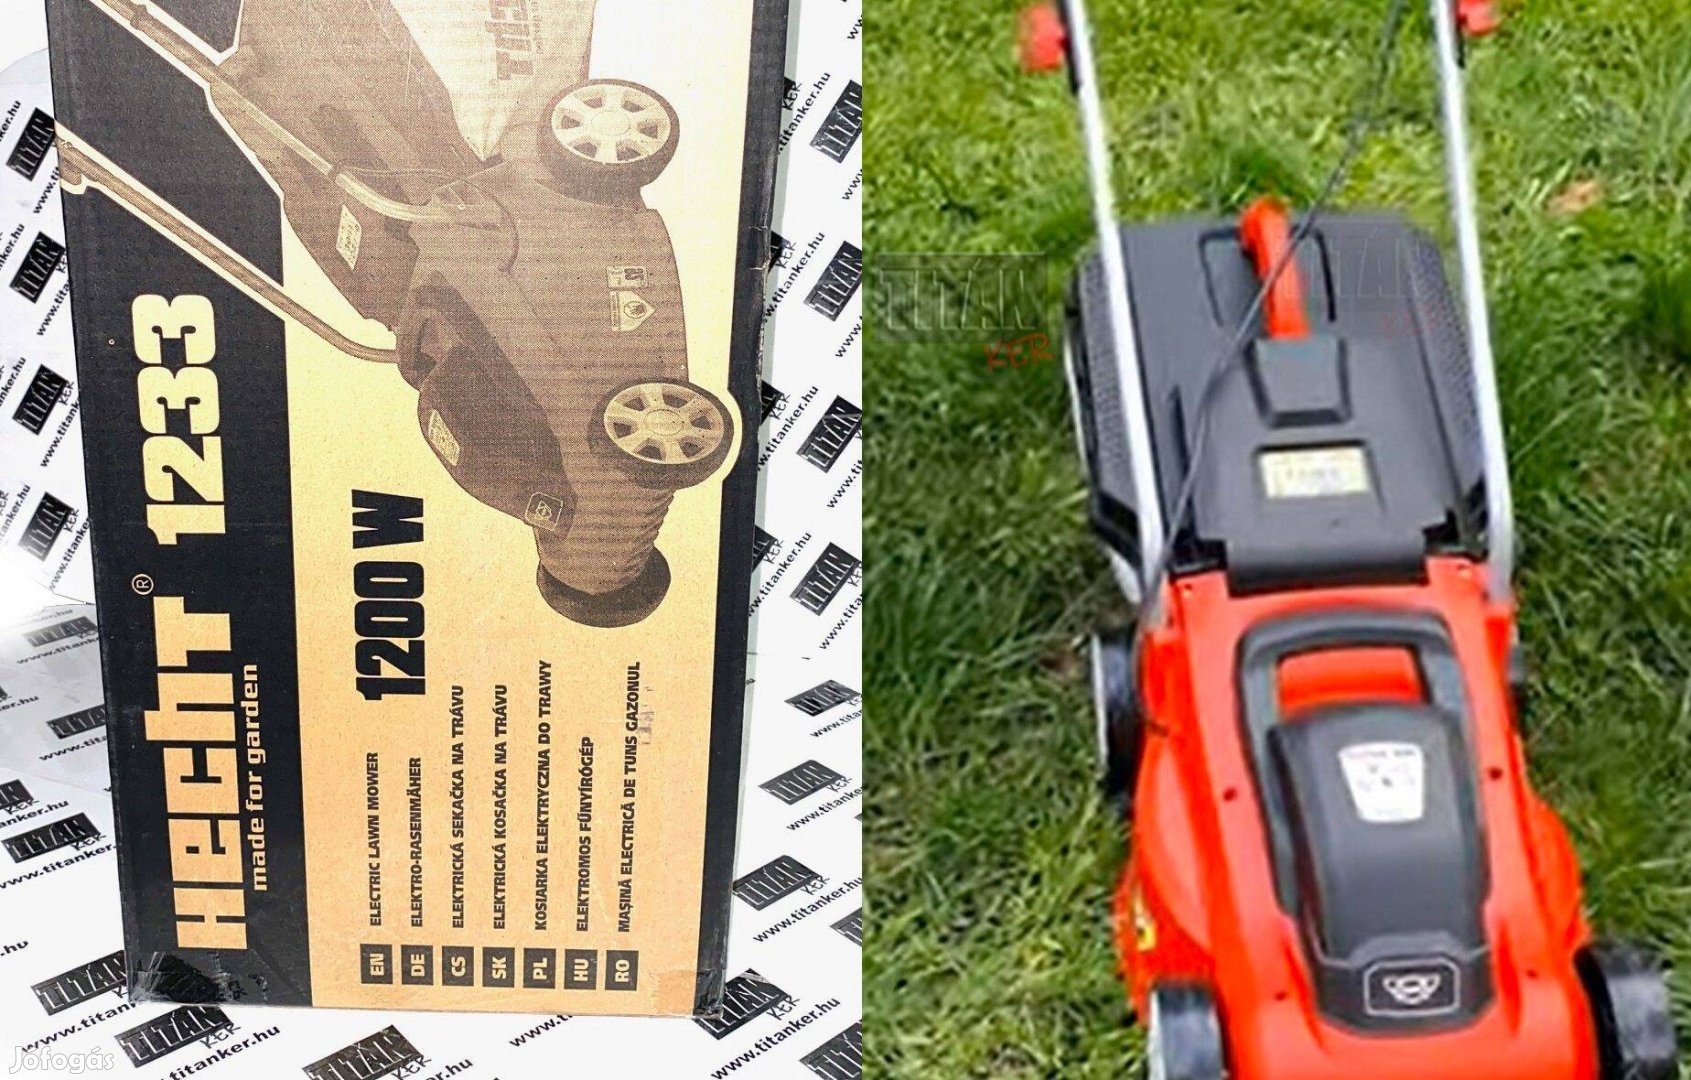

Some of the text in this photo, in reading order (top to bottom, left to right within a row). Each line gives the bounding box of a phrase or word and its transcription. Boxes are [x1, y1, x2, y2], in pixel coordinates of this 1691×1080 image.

[132, 294, 226, 545] 1233
[351, 489, 426, 700] 1200 W
[625, 661, 640, 731] GAZONUL
[241, 664, 268, 891] made for garden
[449, 685, 466, 977] CS ELEKTRICKÁ SEKAČKA NA TRÁVU
[492, 684, 507, 980] SK ELEKTRICKÁ KOSAČKA NA TRÁVU
[532, 660, 552, 980] PL KOSIARKA ELEKTRYCZNA DO TRAWY
[620, 801, 636, 875] ELECTRICĂ
[623, 778, 636, 797] DE
[624, 735, 638, 774] TUNS
[366, 751, 385, 976] EN ELECTRIC LAWN MOWER
[406, 757, 425, 977] DE ELEKTRO-RASENMÄHER
[576, 836, 591, 932] ELEKTROMOS
[573, 958, 589, 982] HU
[614, 959, 630, 983] RO
